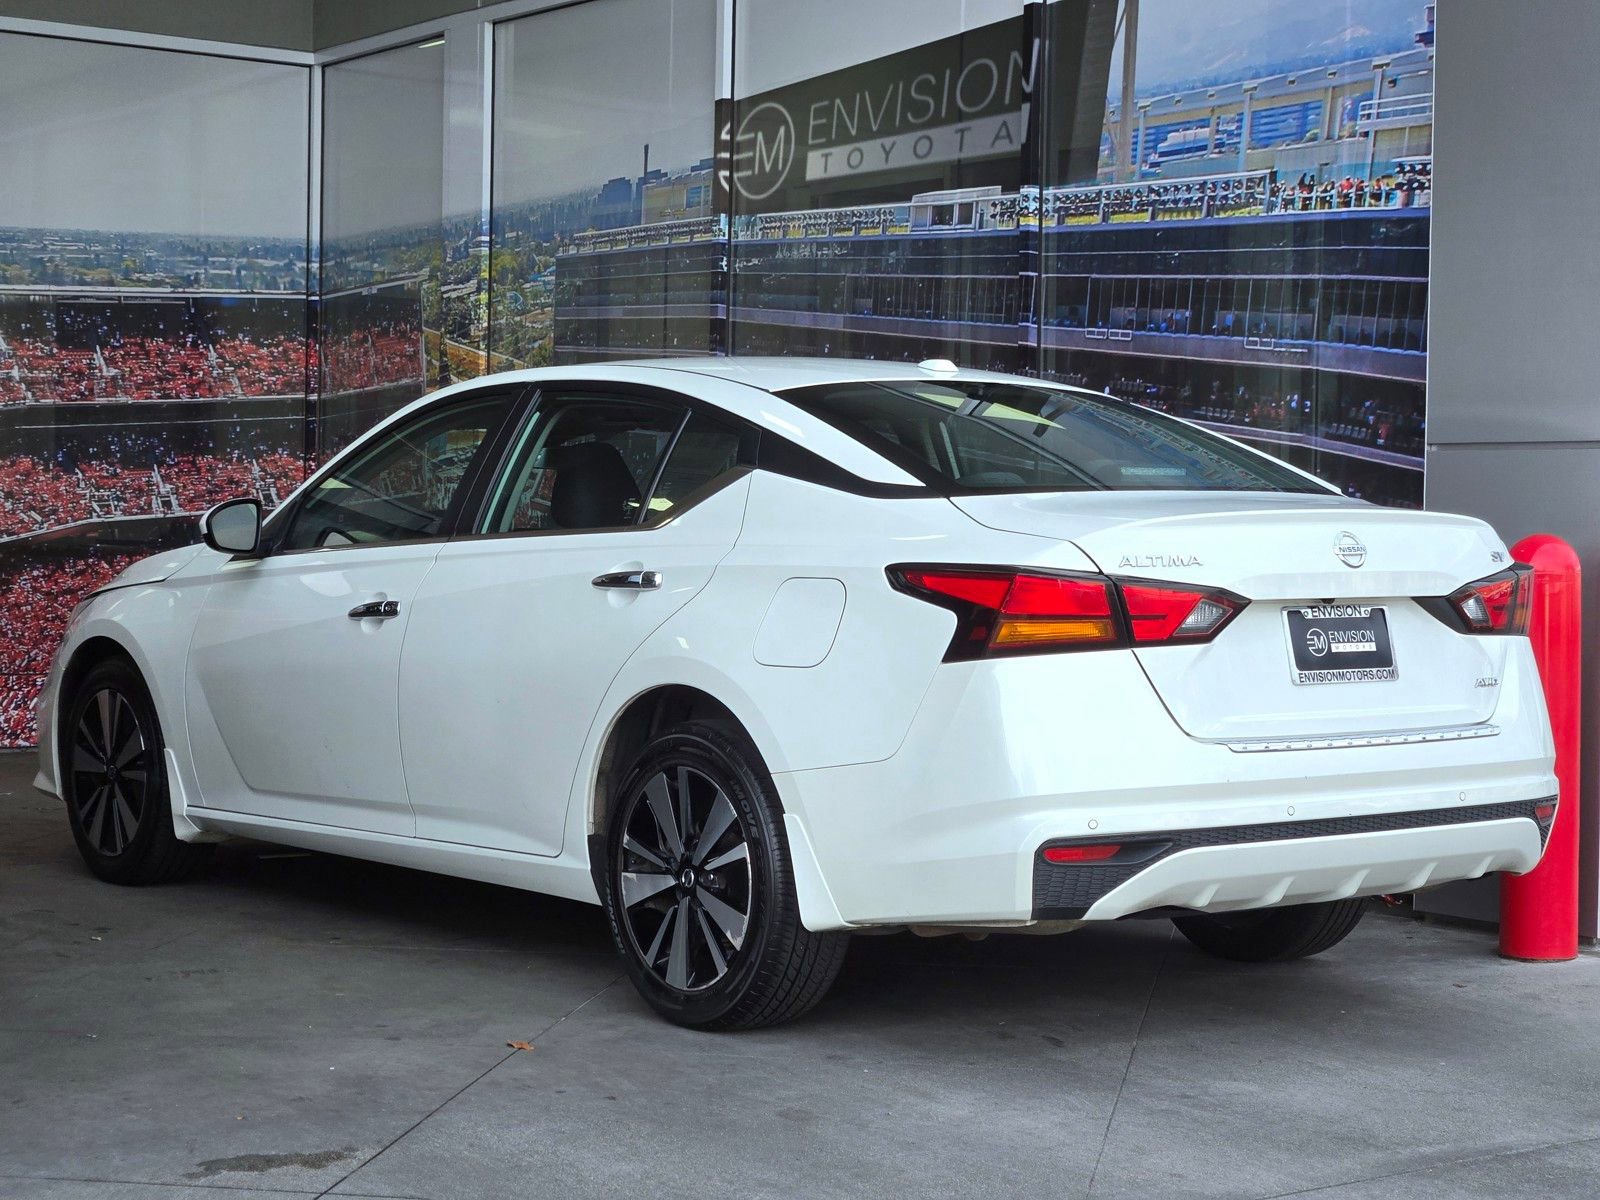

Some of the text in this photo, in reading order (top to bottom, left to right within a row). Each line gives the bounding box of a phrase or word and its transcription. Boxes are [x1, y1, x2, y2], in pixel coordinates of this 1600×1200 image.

[808, 38, 1039, 145] ENVISION
[820, 120, 1013, 174] TOYOTA
[1118, 554, 1204, 568] ALTIMA
[1311, 605, 1362, 618] ENVISION
[1328, 630, 1375, 643] ENVISION
[1298, 669, 1395, 683] ENVISIONMOTORS.COM
